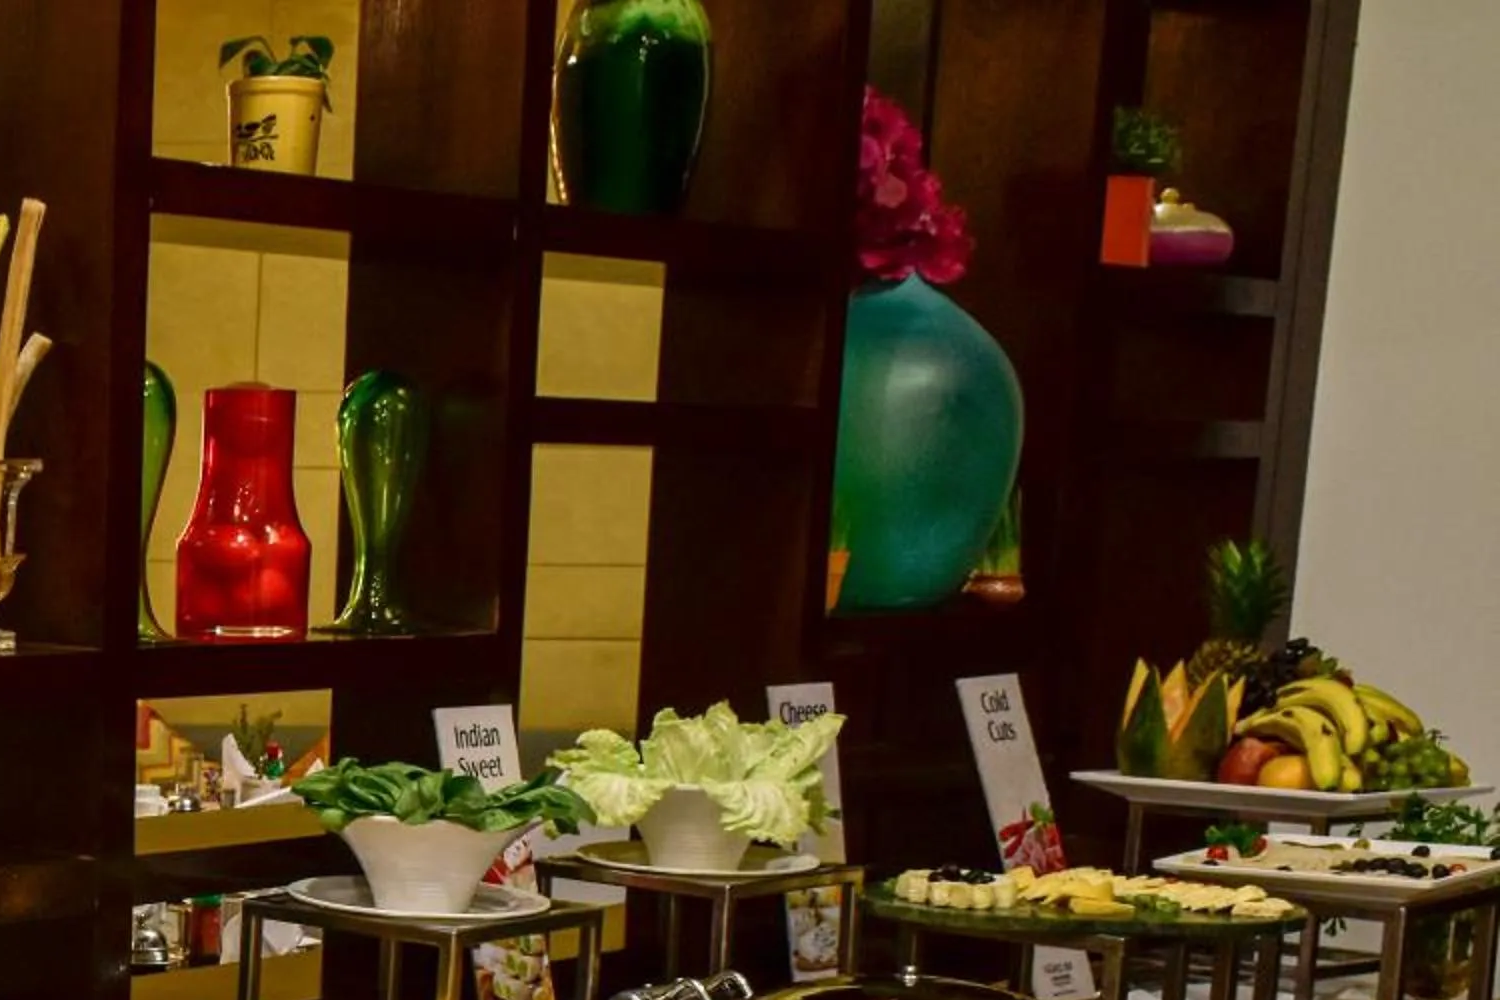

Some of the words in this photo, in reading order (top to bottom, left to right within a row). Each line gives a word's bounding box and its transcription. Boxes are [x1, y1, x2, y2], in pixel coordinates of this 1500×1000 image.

[981, 689, 1010, 713] Cold
[454, 724, 500, 749] Indian
[988, 719, 1016, 741] Cuts
[458, 755, 504, 778] Sweet
